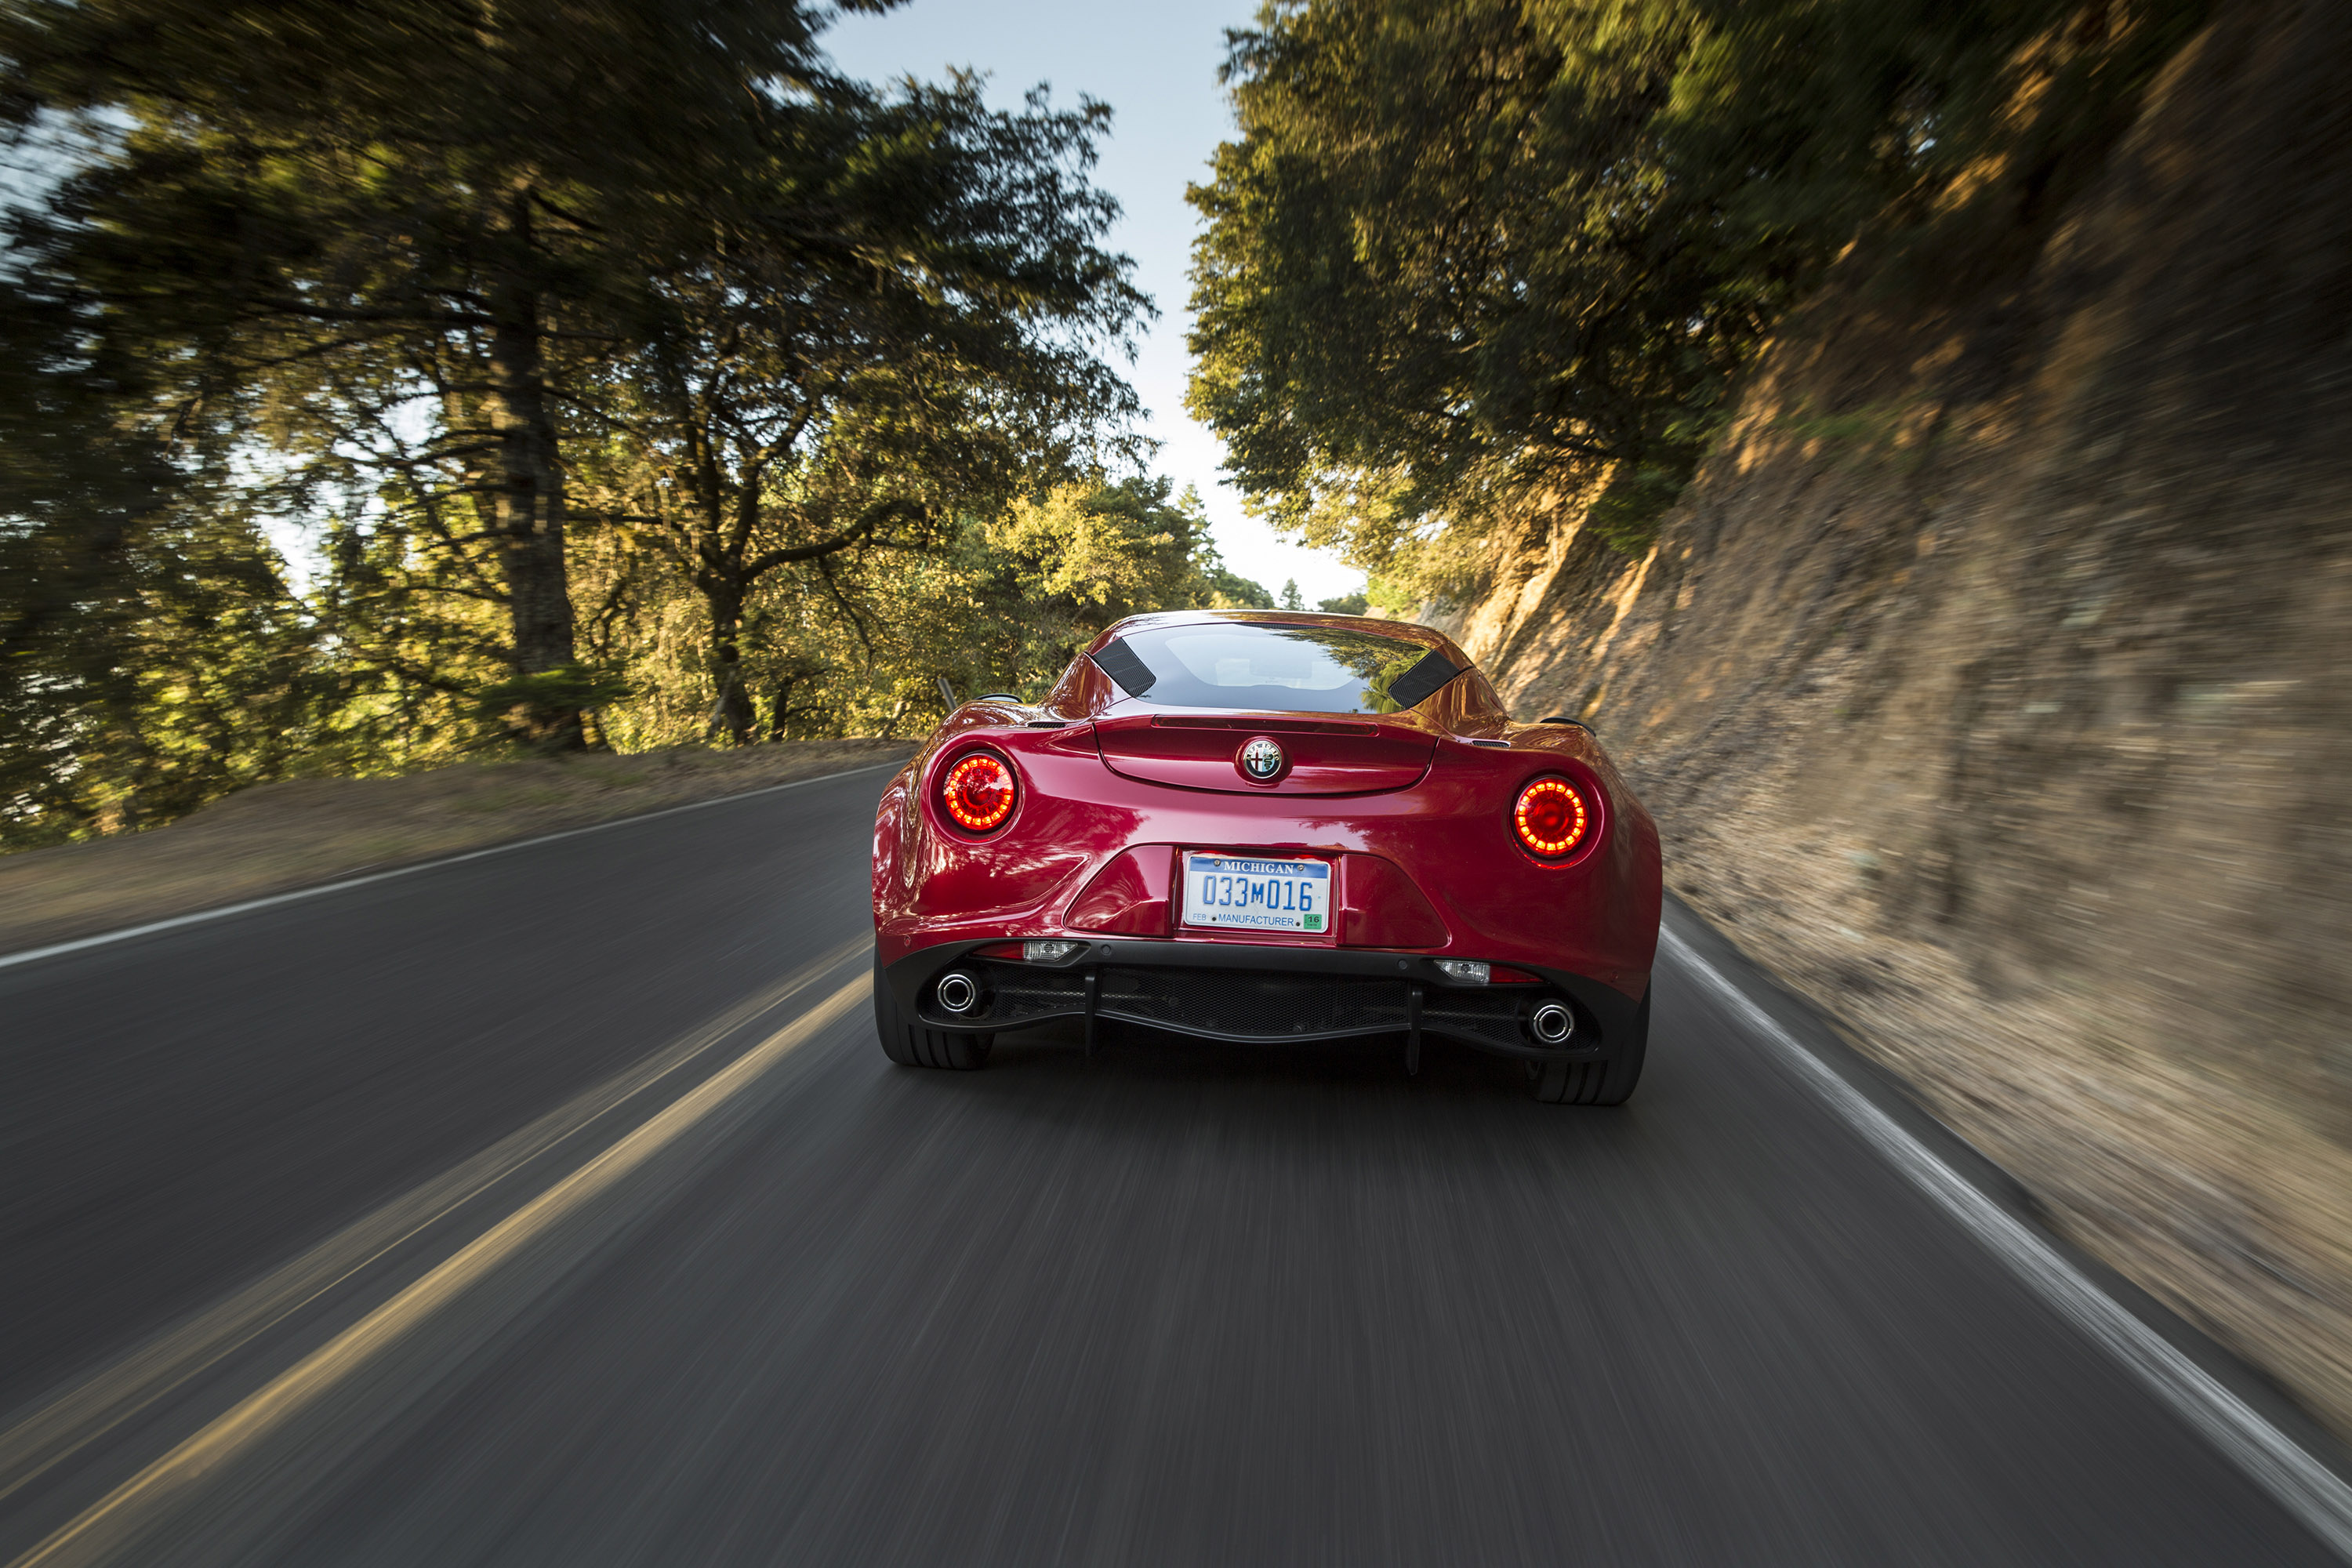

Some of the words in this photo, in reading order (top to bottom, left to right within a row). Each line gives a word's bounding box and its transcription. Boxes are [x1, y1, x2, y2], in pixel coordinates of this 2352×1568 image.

[1223, 861, 1294, 874] MICHIGAN
[1203, 875, 1312, 911] 033M016
[1218, 913, 1294, 927] MANUFACTURER
